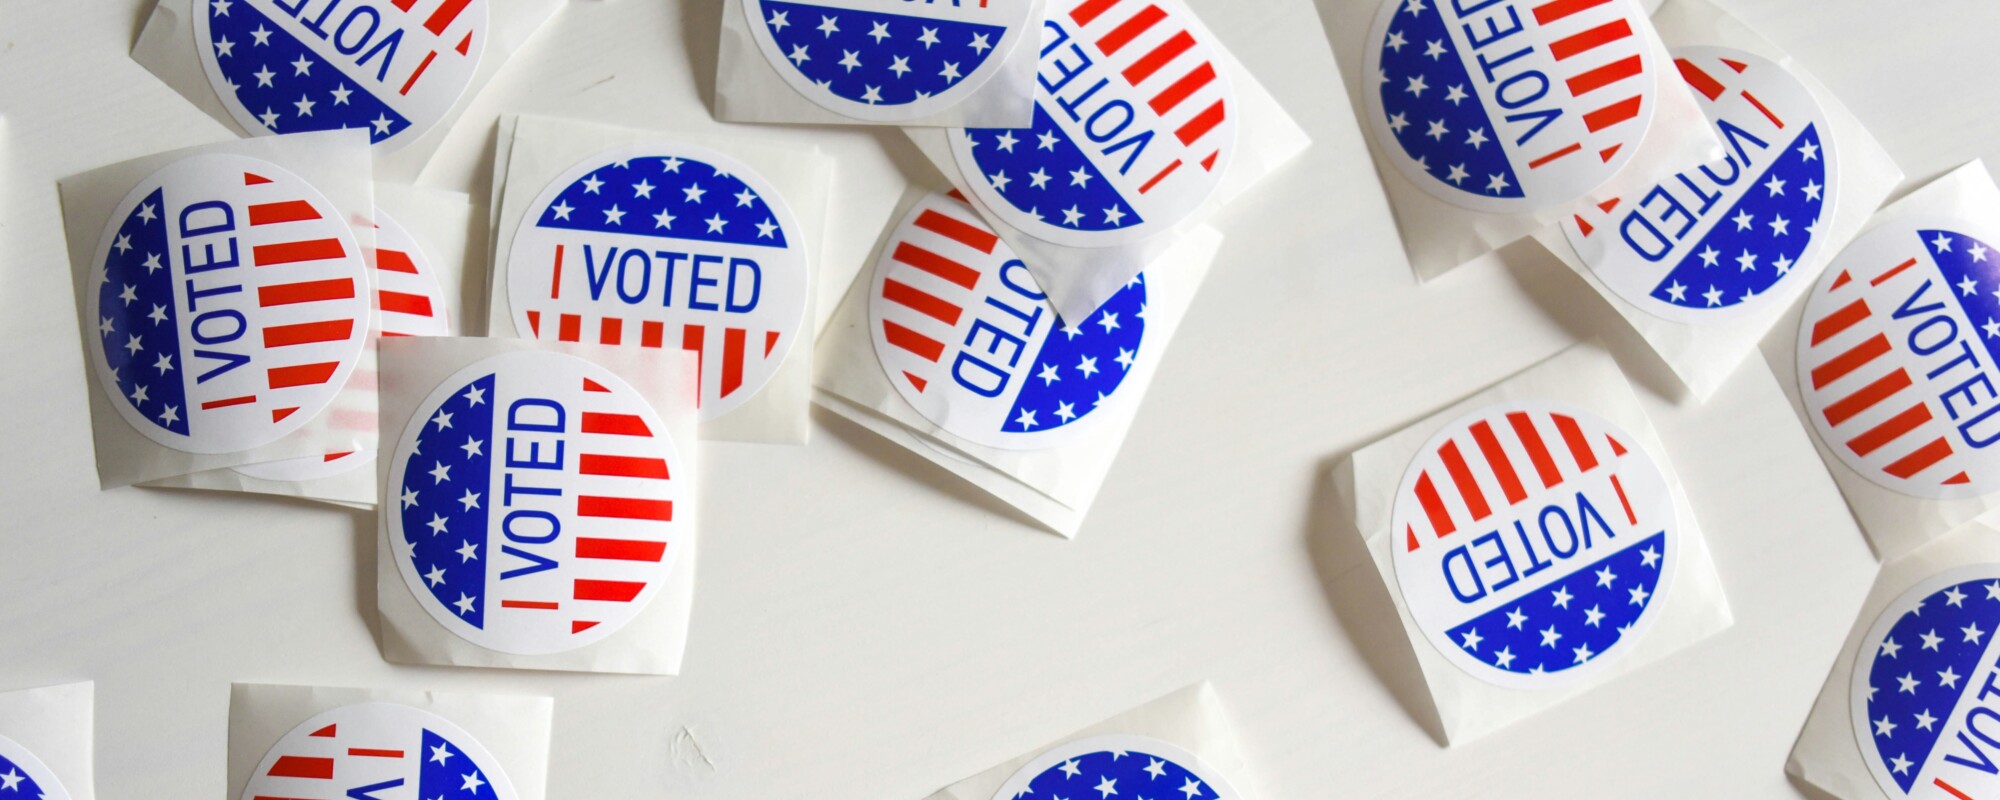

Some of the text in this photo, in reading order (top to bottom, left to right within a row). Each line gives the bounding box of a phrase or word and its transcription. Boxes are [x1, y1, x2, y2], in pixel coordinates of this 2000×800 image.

[400, 50, 438, 96] I
[1741, 90, 1785, 129] I
[1138, 159, 1183, 195] I
[1529, 143, 1582, 170] I
[180, 200, 257, 410] I VOTED
[550, 244, 762, 314] I VOTED
[950, 259, 1048, 399] OTED
[1870, 258, 2000, 449] I VOTED
[500, 397, 567, 610] I VOTED
[1441, 474, 1638, 605] I VOTED
[347, 748, 405, 758] I
